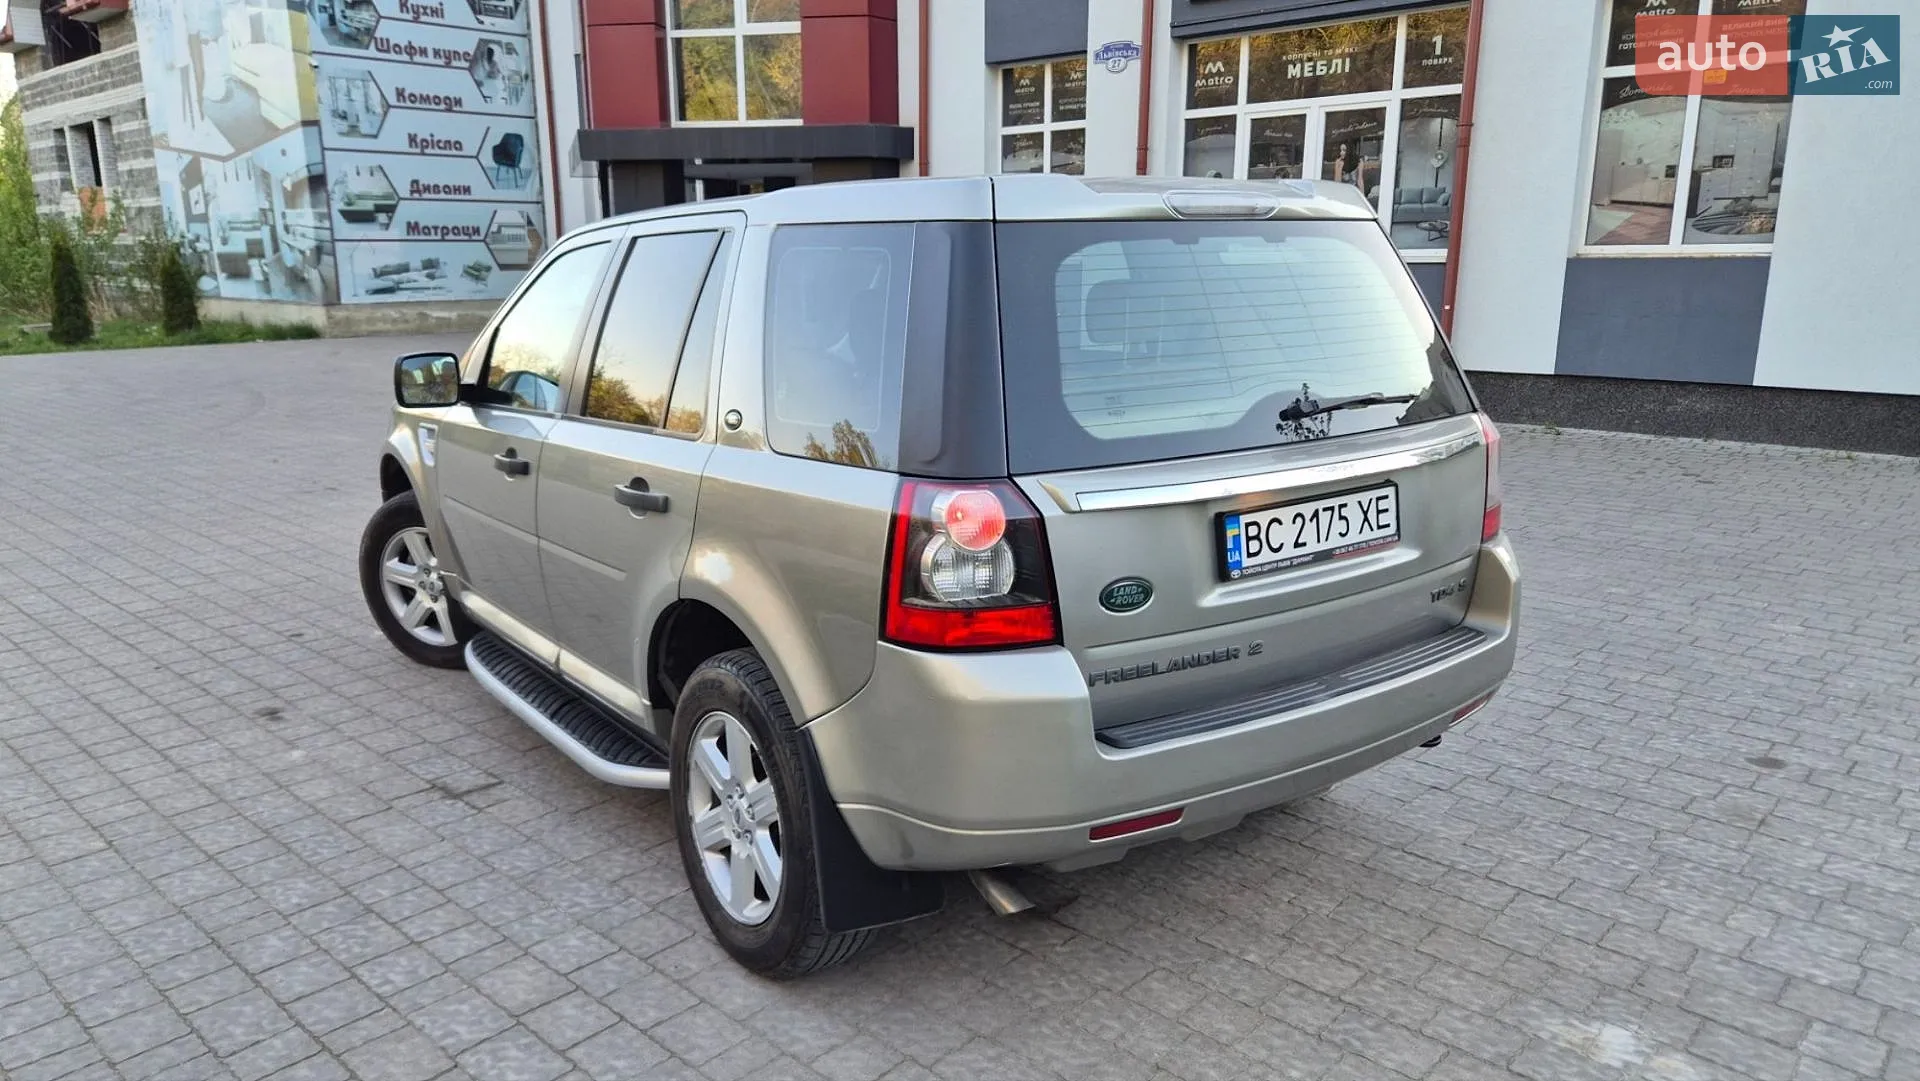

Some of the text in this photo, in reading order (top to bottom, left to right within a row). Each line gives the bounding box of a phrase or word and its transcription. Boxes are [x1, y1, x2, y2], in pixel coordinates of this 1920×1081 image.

[399, 0, 444, 23] Кухні
[374, 37, 472, 66] Шафи купе
[1432, 34, 1442, 55] 1
[1287, 57, 1350, 79] МЕБЛІ
[1195, 76, 1233, 87] Matro
[395, 87, 463, 111] Комоди
[407, 133, 463, 154] Крісла
[409, 179, 472, 197] Дивани
[406, 220, 481, 240] Матраци
[1244, 517, 1285, 558] BC
[1292, 503, 1350, 549] 2175
[1357, 495, 1391, 534] XE
[1227, 551, 1241, 562] UA
[1113, 586, 1137, 596] LAND
[1115, 594, 1146, 606] ROVER
[1089, 640, 1263, 687] FREELANDER 2
